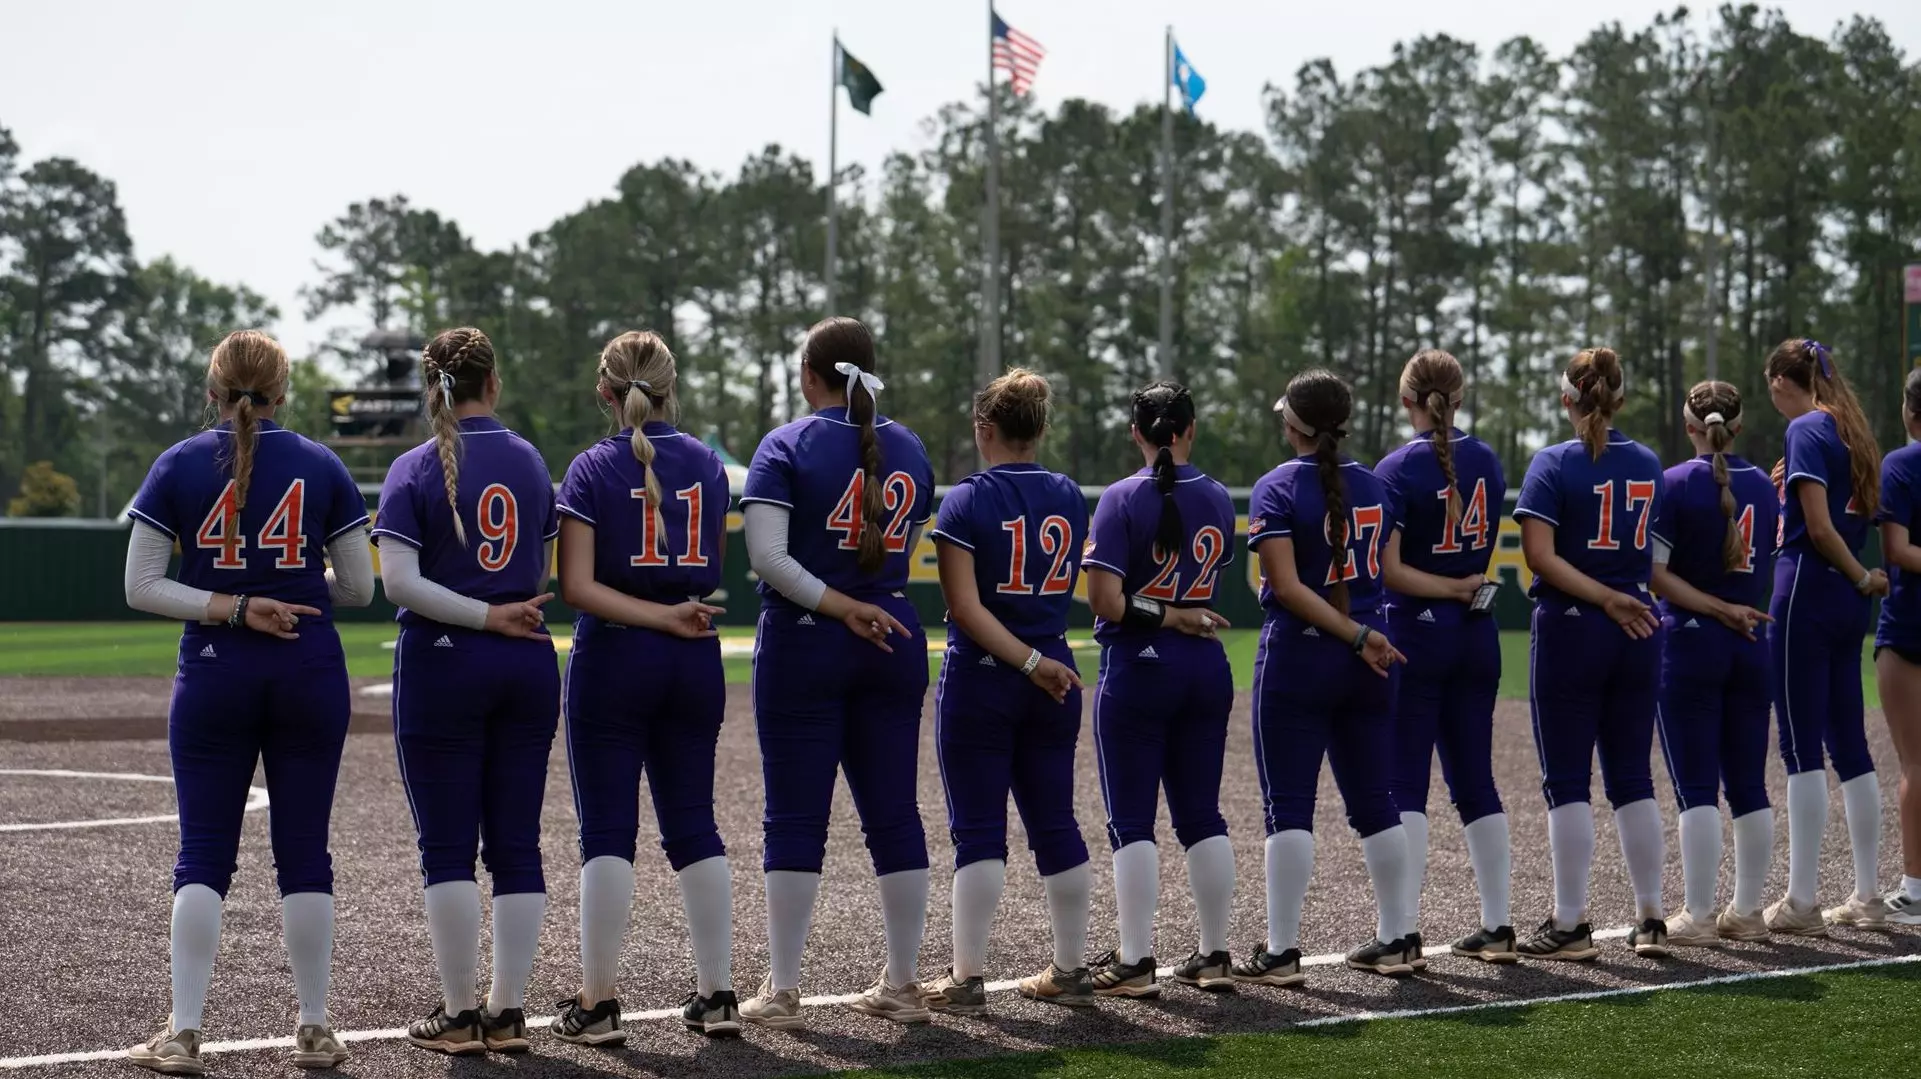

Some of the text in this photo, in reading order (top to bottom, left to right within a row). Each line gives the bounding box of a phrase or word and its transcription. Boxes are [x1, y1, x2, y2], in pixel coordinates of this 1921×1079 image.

[197, 478, 307, 569] 44
[477, 483, 518, 571] 9
[630, 482, 708, 566] 11
[826, 468, 917, 552] 42
[1432, 478, 1489, 554] 14
[1587, 479, 1655, 550] 17
[997, 515, 1072, 596] 12
[1136, 525, 1224, 601] 22
